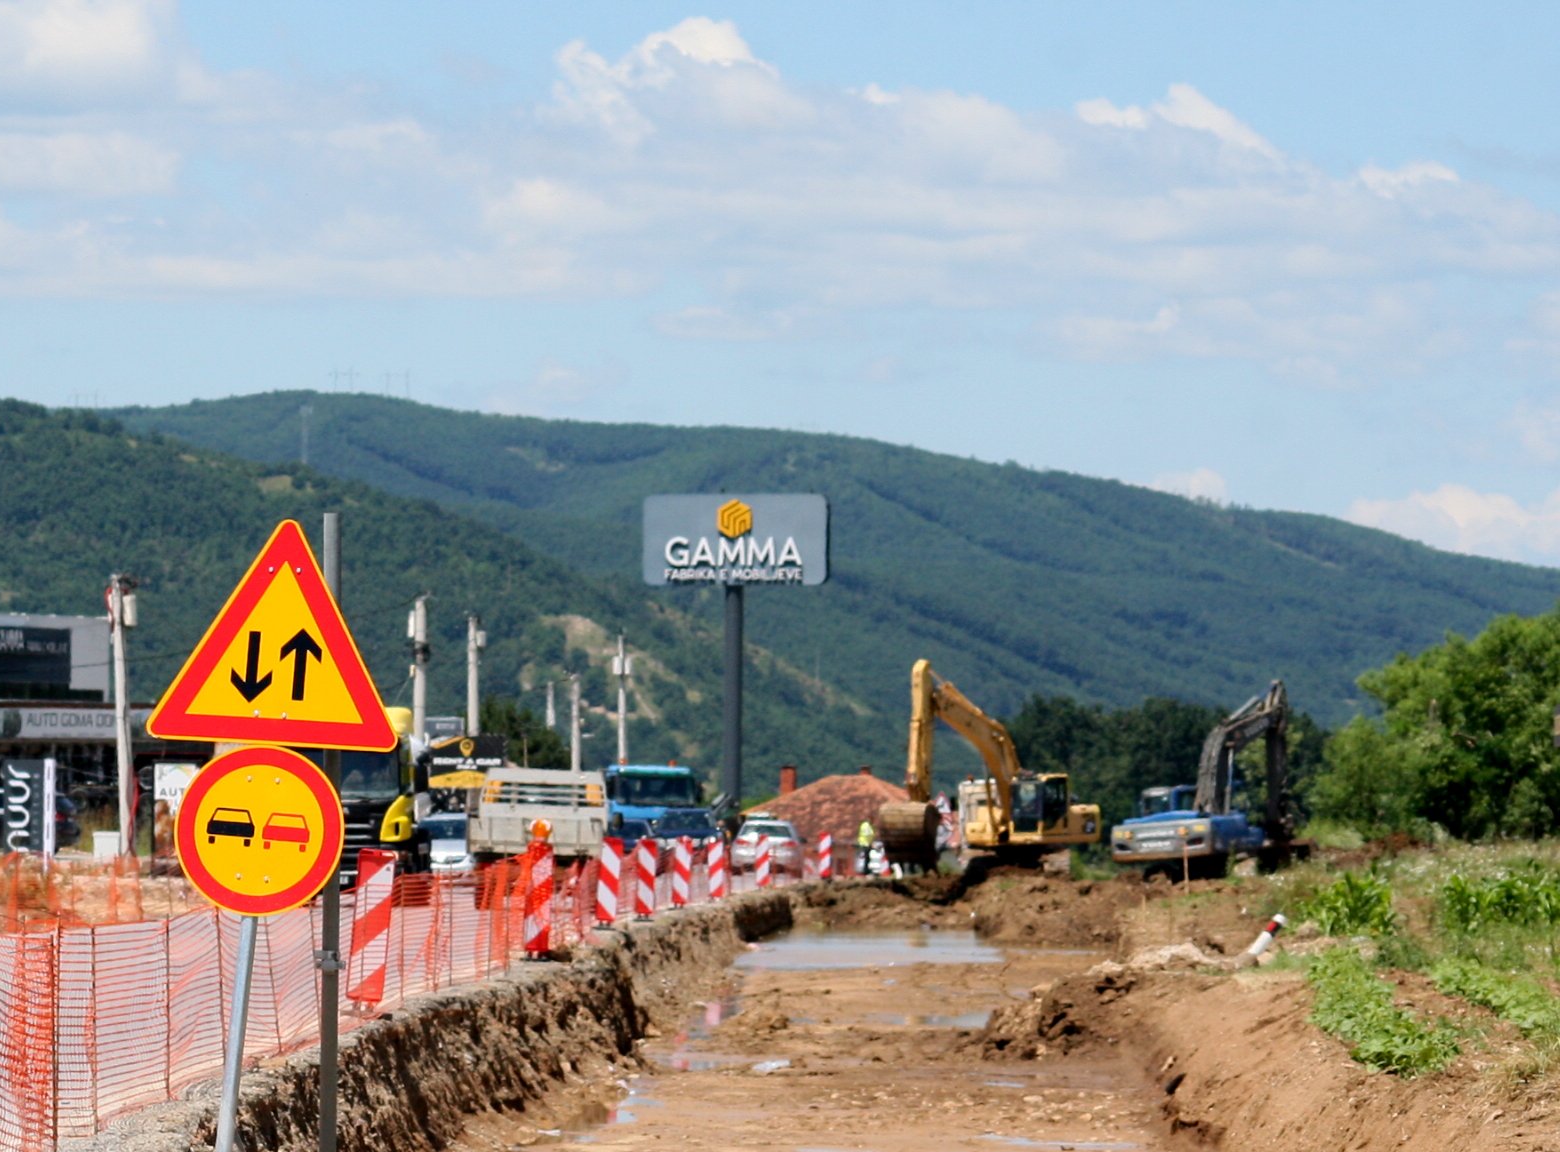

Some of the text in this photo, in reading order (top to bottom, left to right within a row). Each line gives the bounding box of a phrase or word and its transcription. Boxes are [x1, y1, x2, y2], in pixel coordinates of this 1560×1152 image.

[664, 536, 803, 567] GAMMA
[664, 568, 803, 581] FABRIKA E MOBILJEVE
[26, 712, 59, 727] AUTO
[60, 712, 93, 728] GOMA
